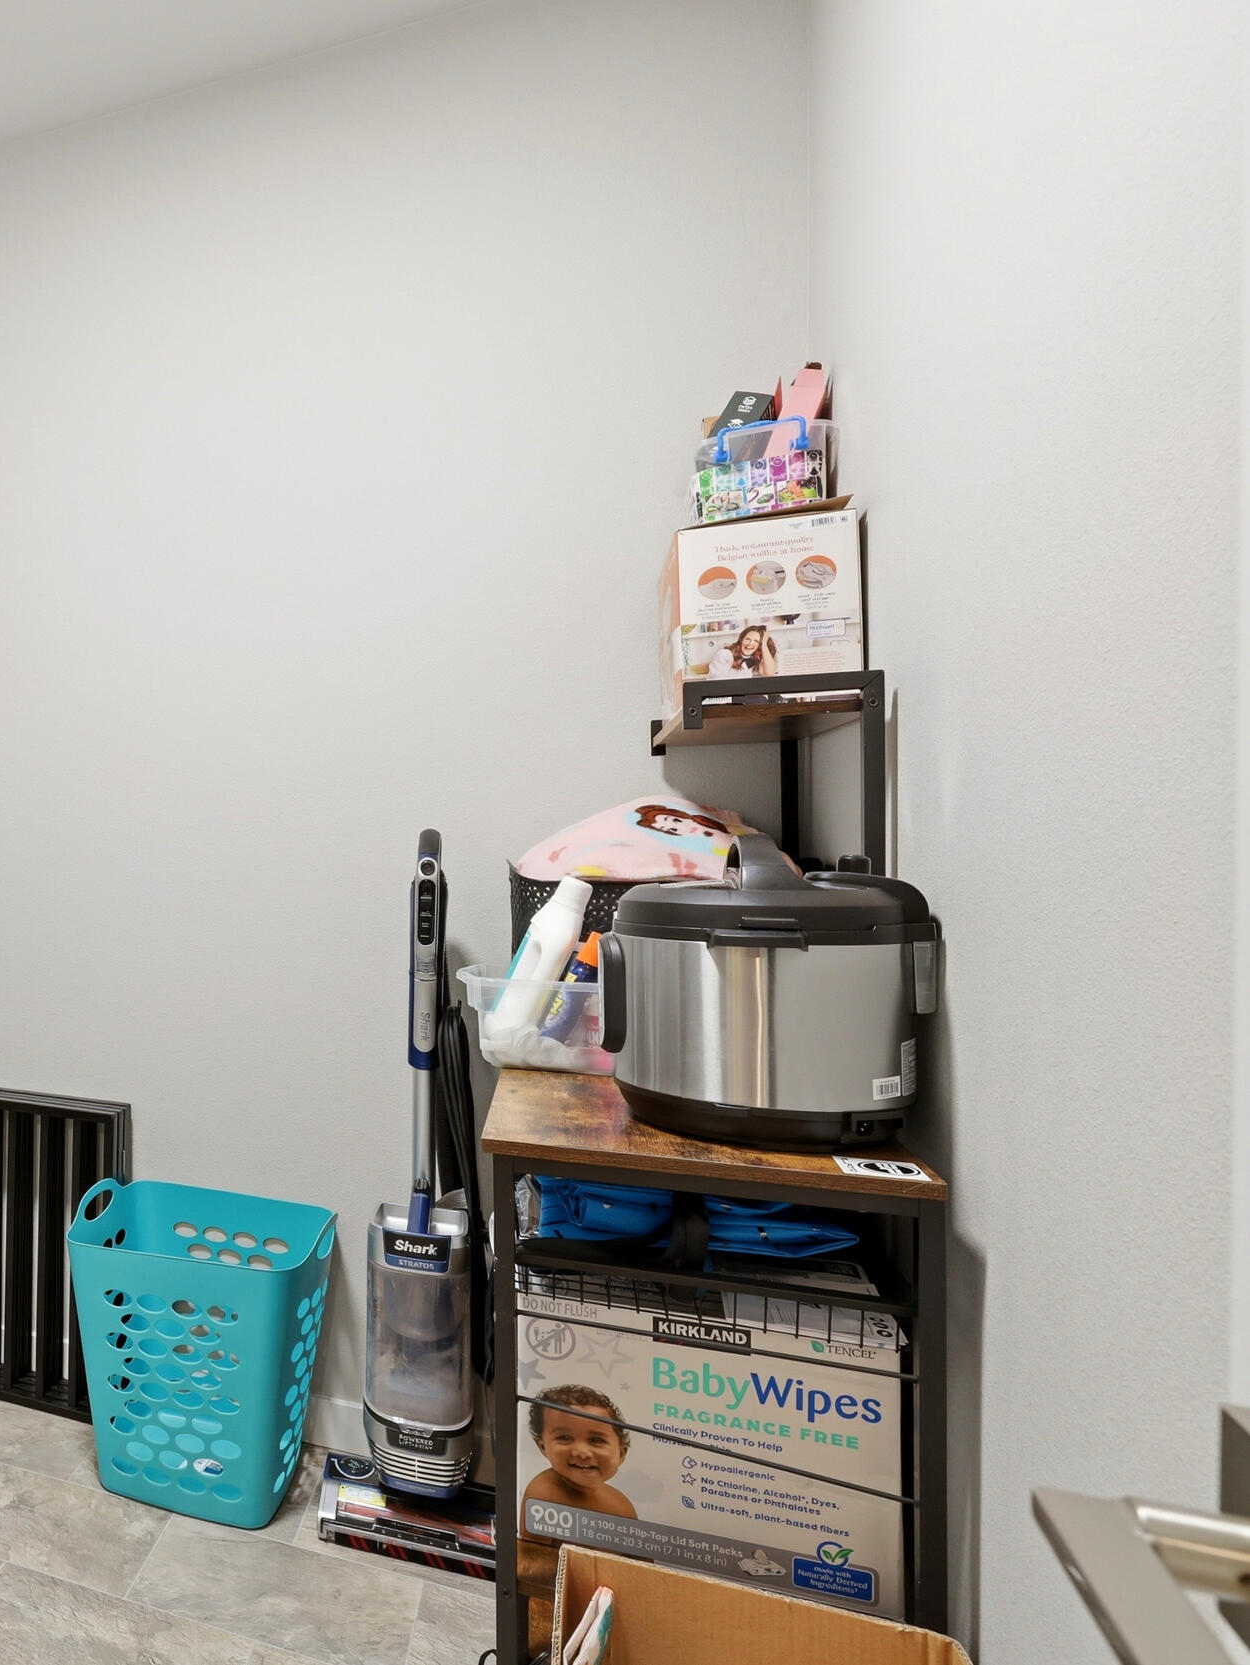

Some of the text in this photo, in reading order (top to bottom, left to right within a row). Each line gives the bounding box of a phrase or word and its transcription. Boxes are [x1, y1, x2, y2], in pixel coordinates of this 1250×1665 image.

[420, 1009, 431, 1041] Shark
[394, 1239, 438, 1255] Shark
[398, 1259, 435, 1270] STRATOS
[522, 1296, 598, 1319] DO NOT FLUSH
[658, 1320, 748, 1345] KIRKLAND
[652, 1422, 699, 1438] Clinically
[701, 1431, 740, 1445] Proven
[742, 1438, 755, 1448] To
[757, 1440, 783, 1453] Help
[653, 1402, 860, 1450] FRAGRANCE FREE
[398, 1434, 434, 1446] POWERED
[701, 1461, 776, 1482] Hypoallergenic
[701, 1476, 715, 1486] No
[717, 1479, 760, 1496] Chlorine,
[811, 1497, 840, 1510] Dyes,
[701, 1486, 821, 1516] Parabens or Phthalates
[530, 1504, 573, 1529] 900
[701, 1502, 850, 1537] Ultra-soft, plant-based fibers
[533, 1522, 571, 1537] WIPES
[598, 1519, 615, 1531] 100
[617, 1524, 627, 1533] ct
[629, 1526, 669, 1544] Flip-Top
[671, 1534, 686, 1546] Lid
[689, 1538, 709, 1551] Soft
[712, 1543, 743, 1558] Packs
[581, 1527, 594, 1539] 18
[595, 1532, 612, 1543] cm
[622, 1535, 643, 1550] 20.3
[644, 1542, 662, 1553] cm
[663, 1544, 681, 1558] (7.1
[684, 1549, 694, 1559] in
[704, 1553, 711, 1563] 8
[713, 1555, 727, 1568] in)
[797, 1568, 868, 1589] Naturally Derived
[814, 1565, 852, 1578] made with
